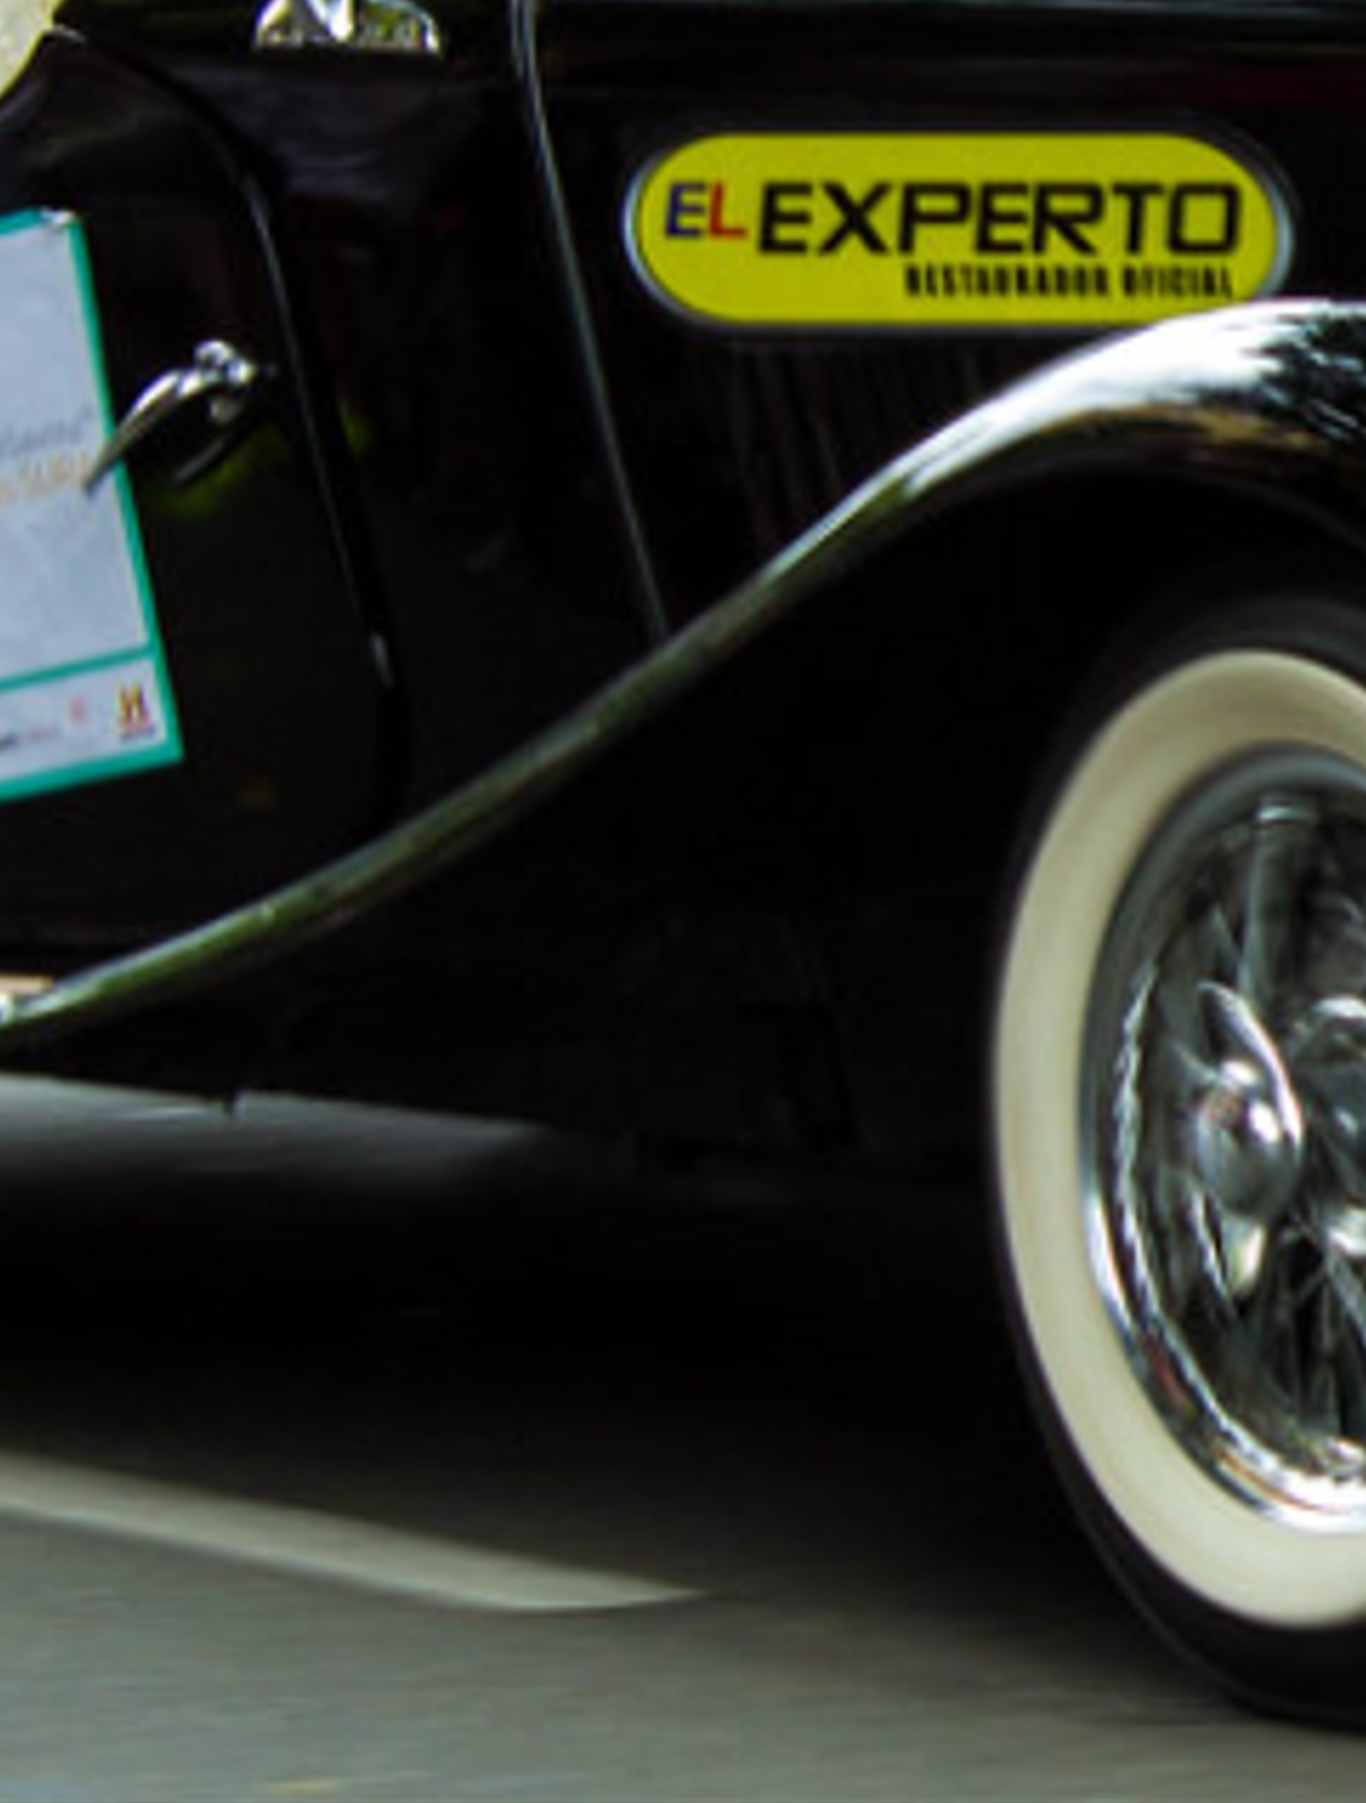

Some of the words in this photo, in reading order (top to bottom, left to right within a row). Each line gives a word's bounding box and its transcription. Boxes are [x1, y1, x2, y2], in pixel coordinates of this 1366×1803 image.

[663, 180, 748, 238] EL
[757, 181, 1243, 256] EXPERTO
[904, 262, 1112, 298] RESTAURADOR
[1121, 262, 1236, 298] OFICIAL
